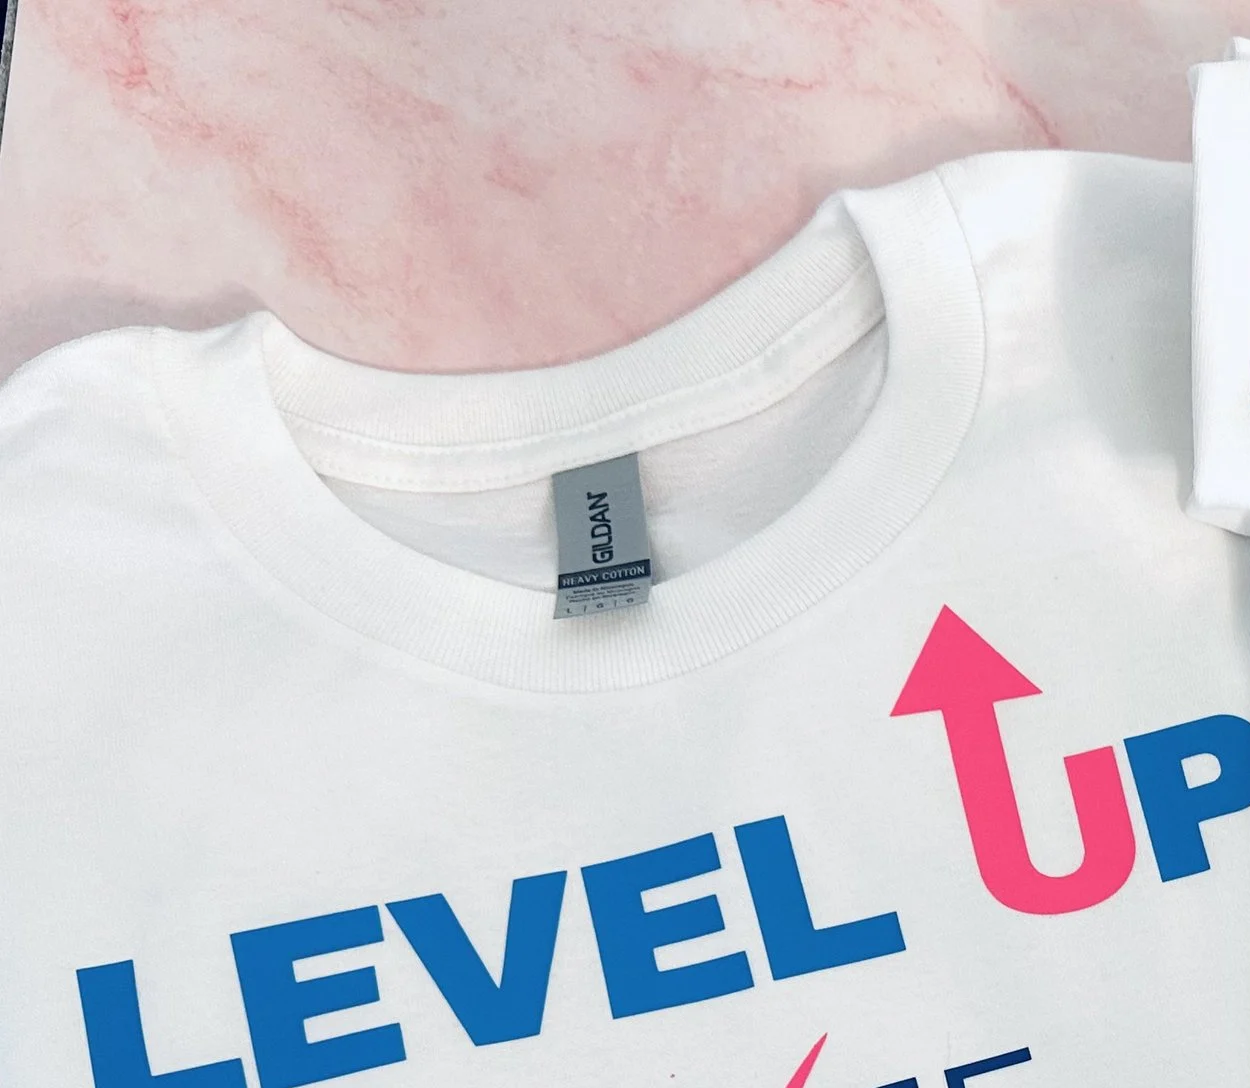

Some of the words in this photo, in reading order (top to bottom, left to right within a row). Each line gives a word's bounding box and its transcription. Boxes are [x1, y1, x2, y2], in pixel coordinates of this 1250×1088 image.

[587, 491, 614, 564] GILDAN
[562, 575, 599, 587] HEAVY
[602, 566, 645, 580] COTTON
